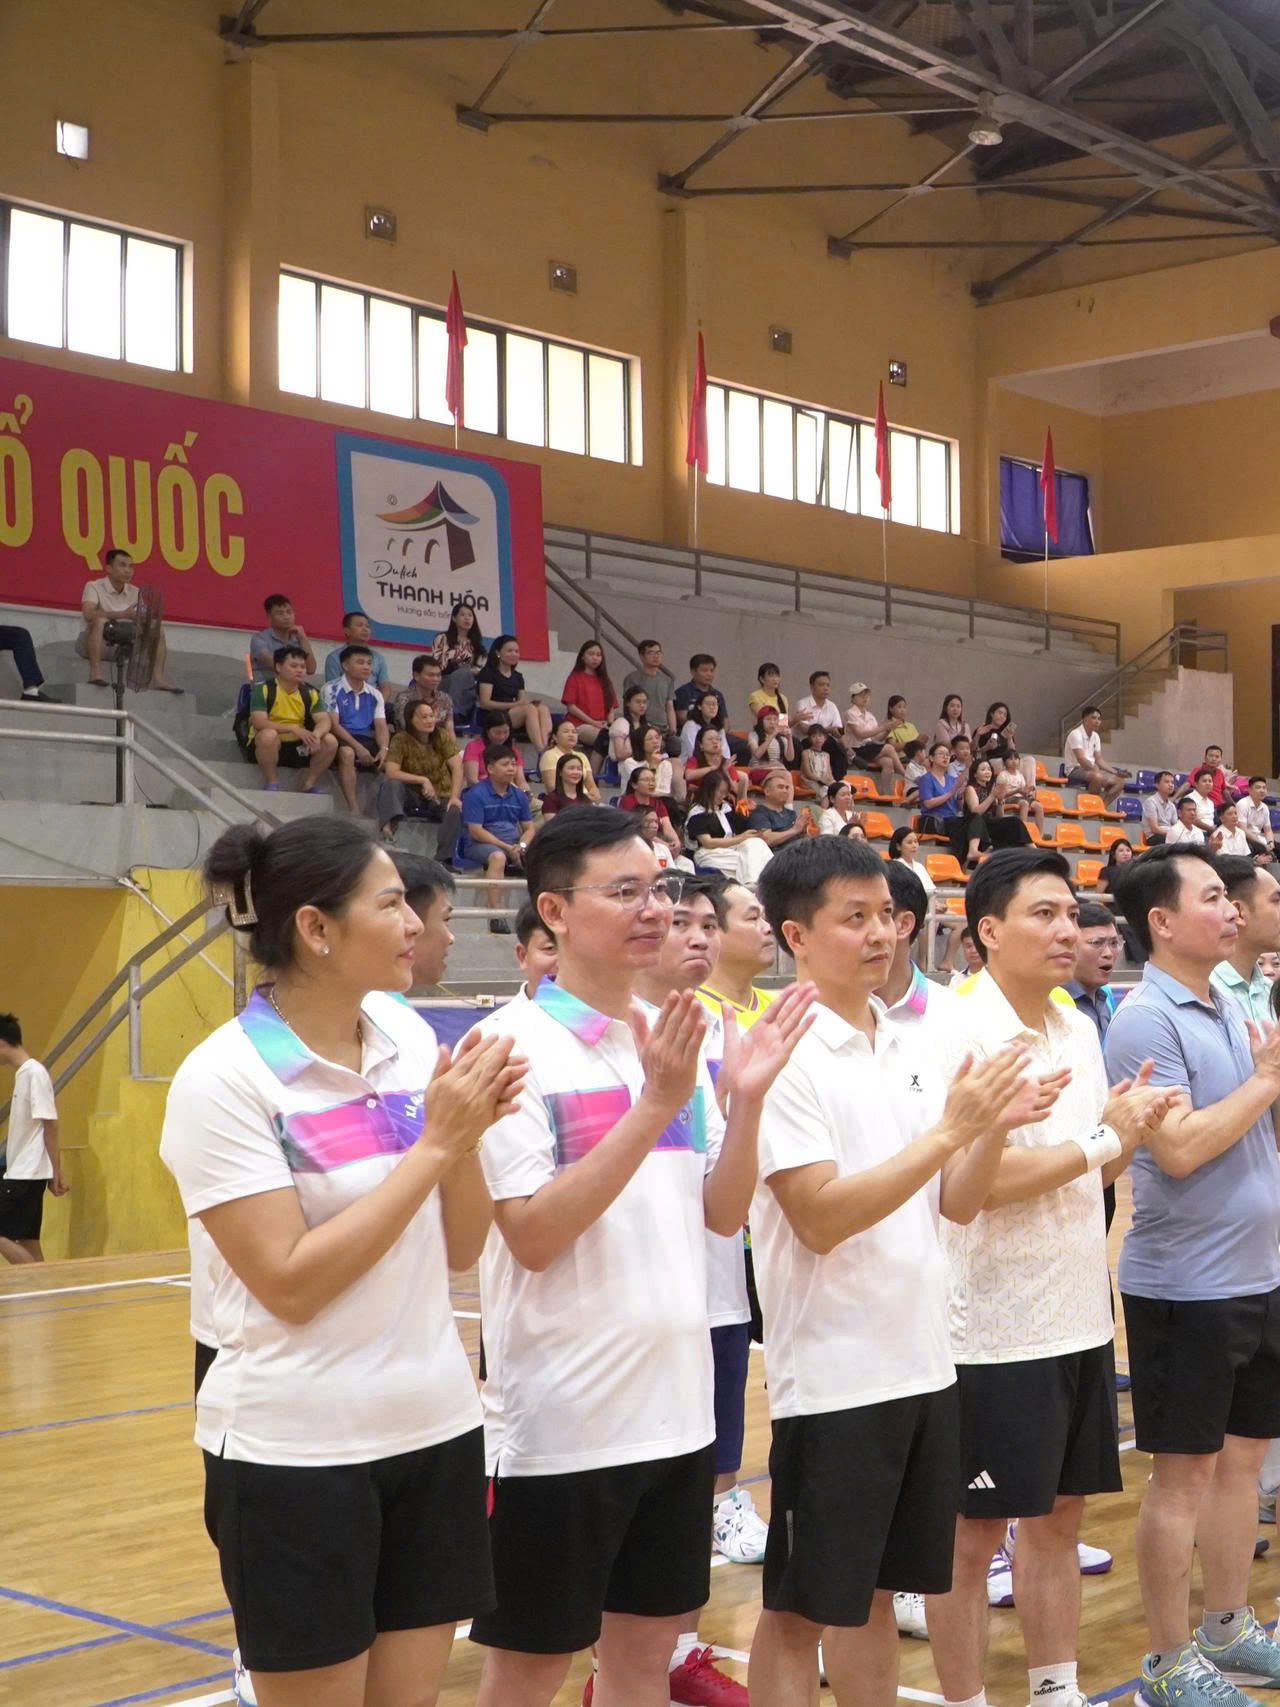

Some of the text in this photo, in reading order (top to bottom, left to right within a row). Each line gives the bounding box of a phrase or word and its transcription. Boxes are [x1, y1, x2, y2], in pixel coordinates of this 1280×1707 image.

[0, 393, 246, 577] Ổ QUỐC
[368, 559, 399, 579] Du
[376, 581, 489, 611] THANH HÓA
